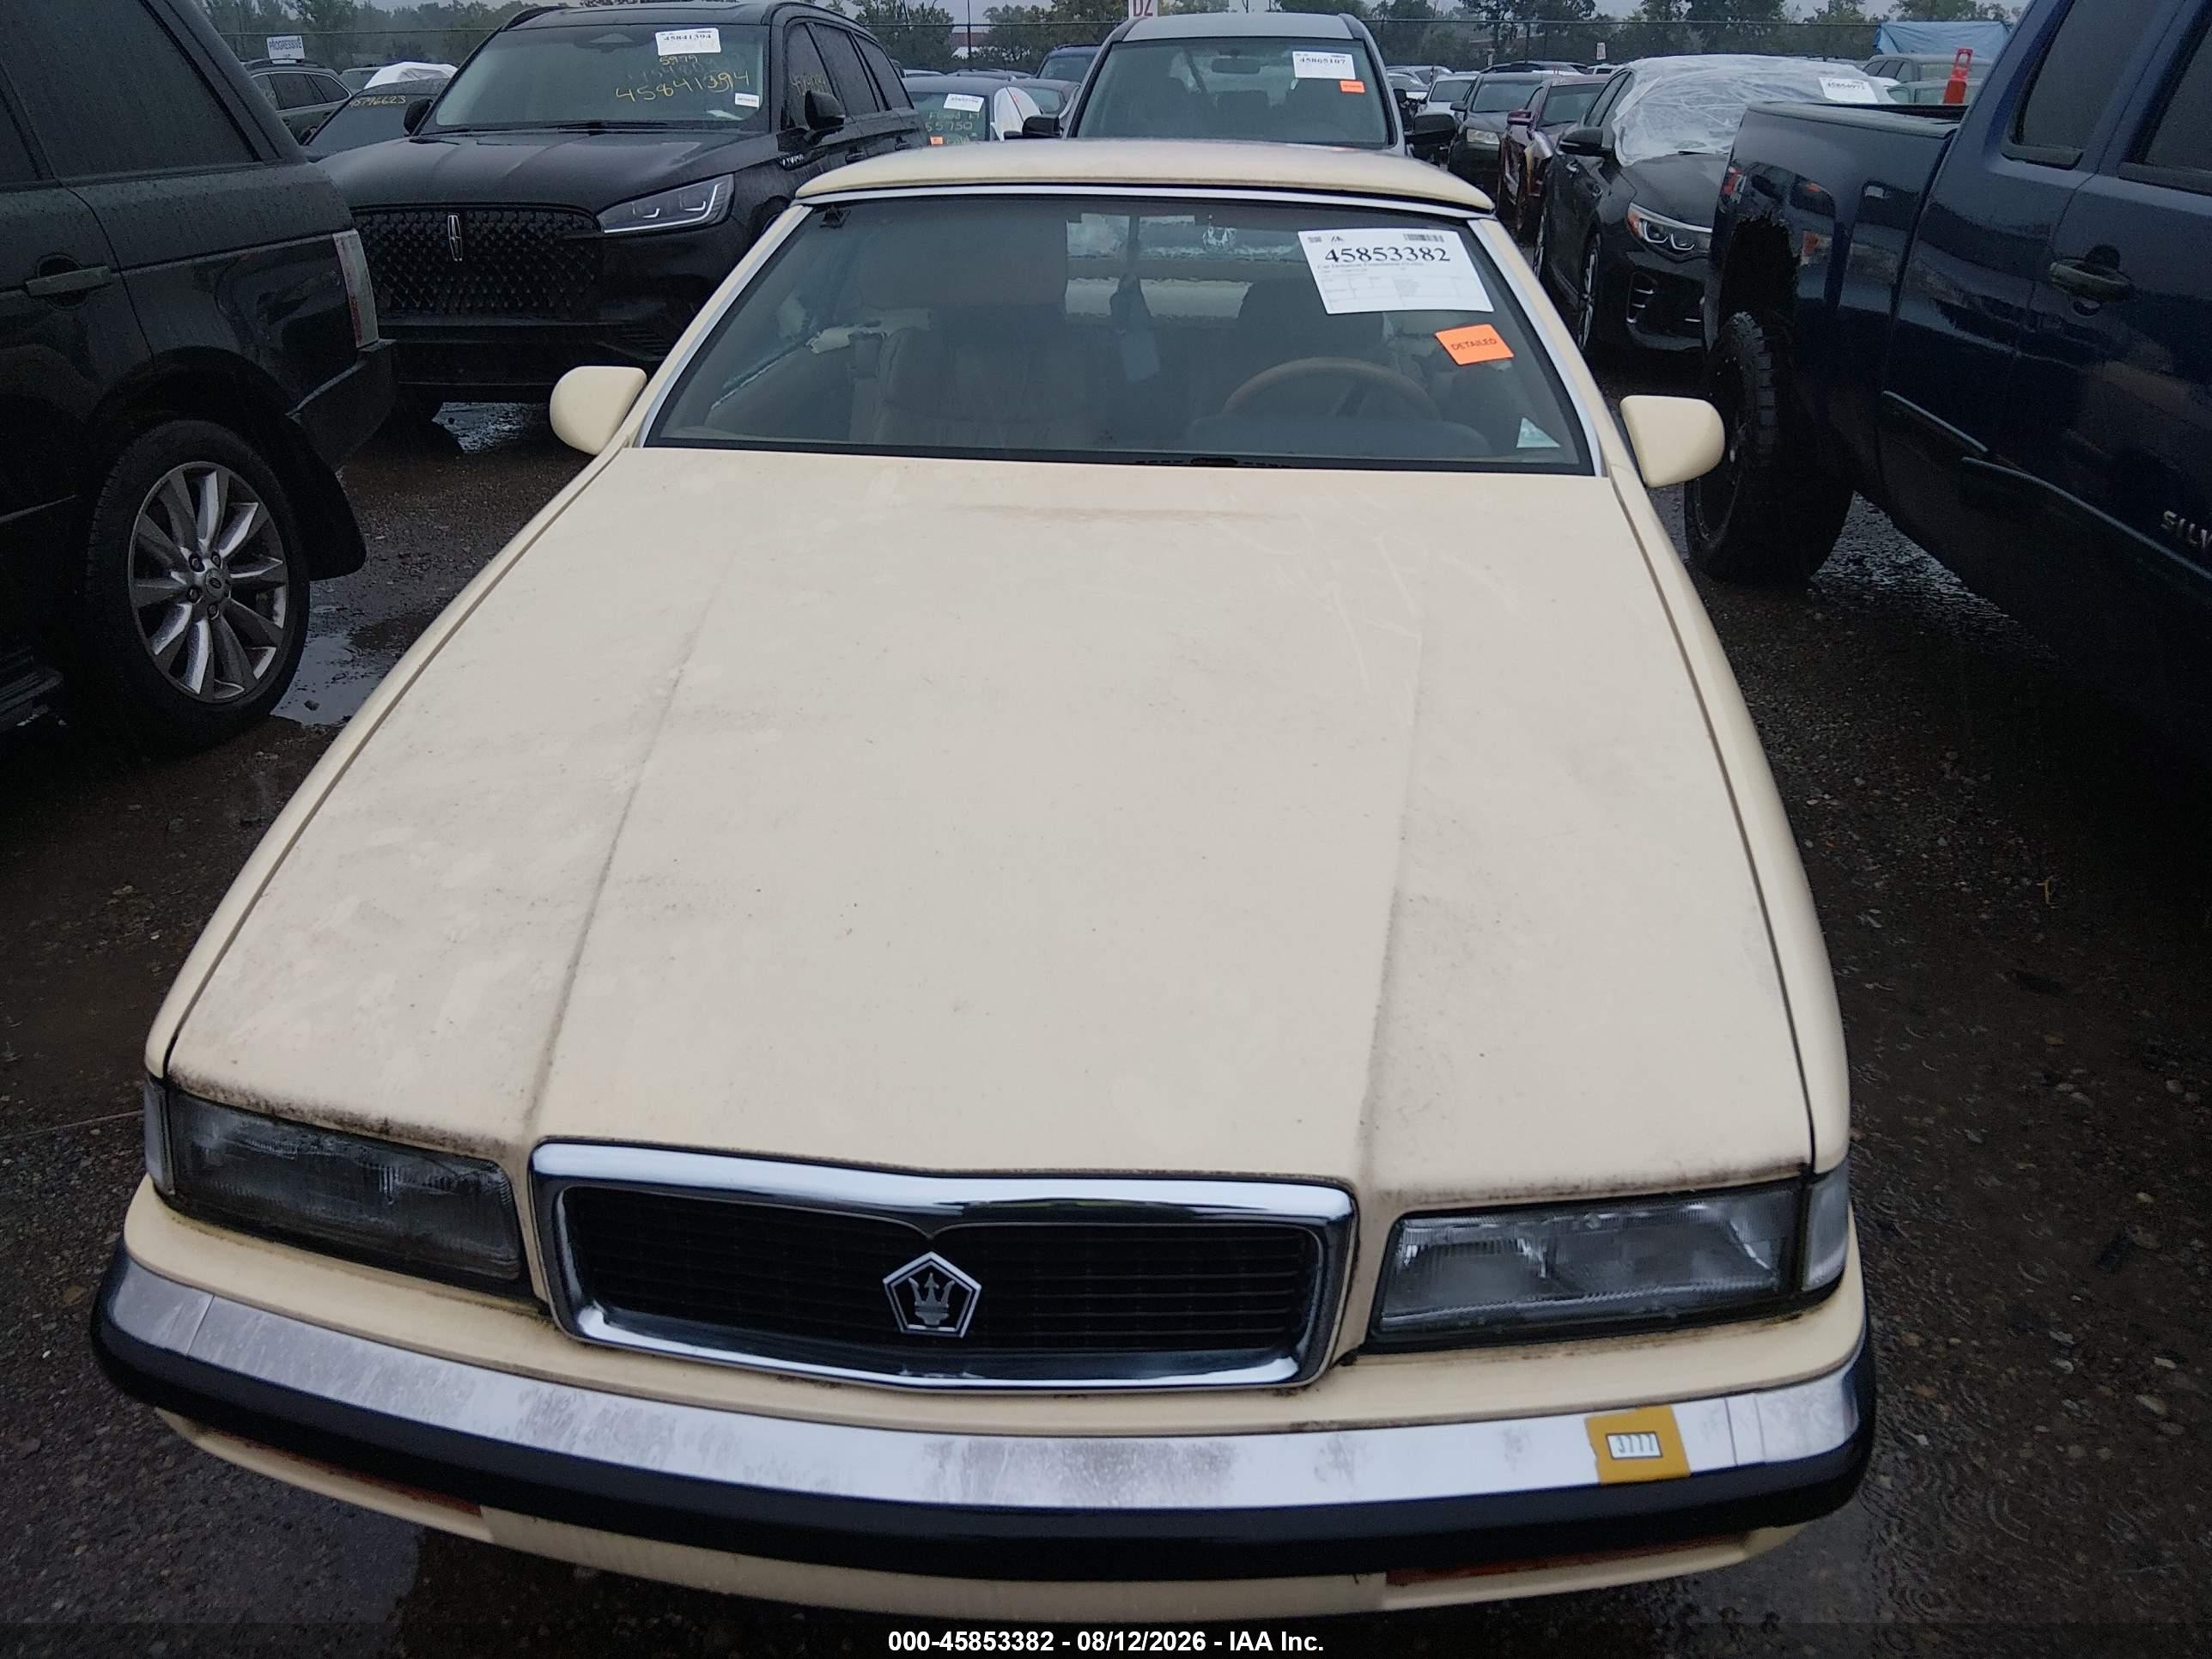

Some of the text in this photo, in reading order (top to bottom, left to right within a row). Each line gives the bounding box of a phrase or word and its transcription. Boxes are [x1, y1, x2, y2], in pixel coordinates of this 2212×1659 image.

[269, 40, 302, 50] PROGRESSIVE
[616, 70, 750, 102] 45841394
[1324, 246, 1451, 263] 45853382
[1450, 337, 1498, 351] DETAILED
